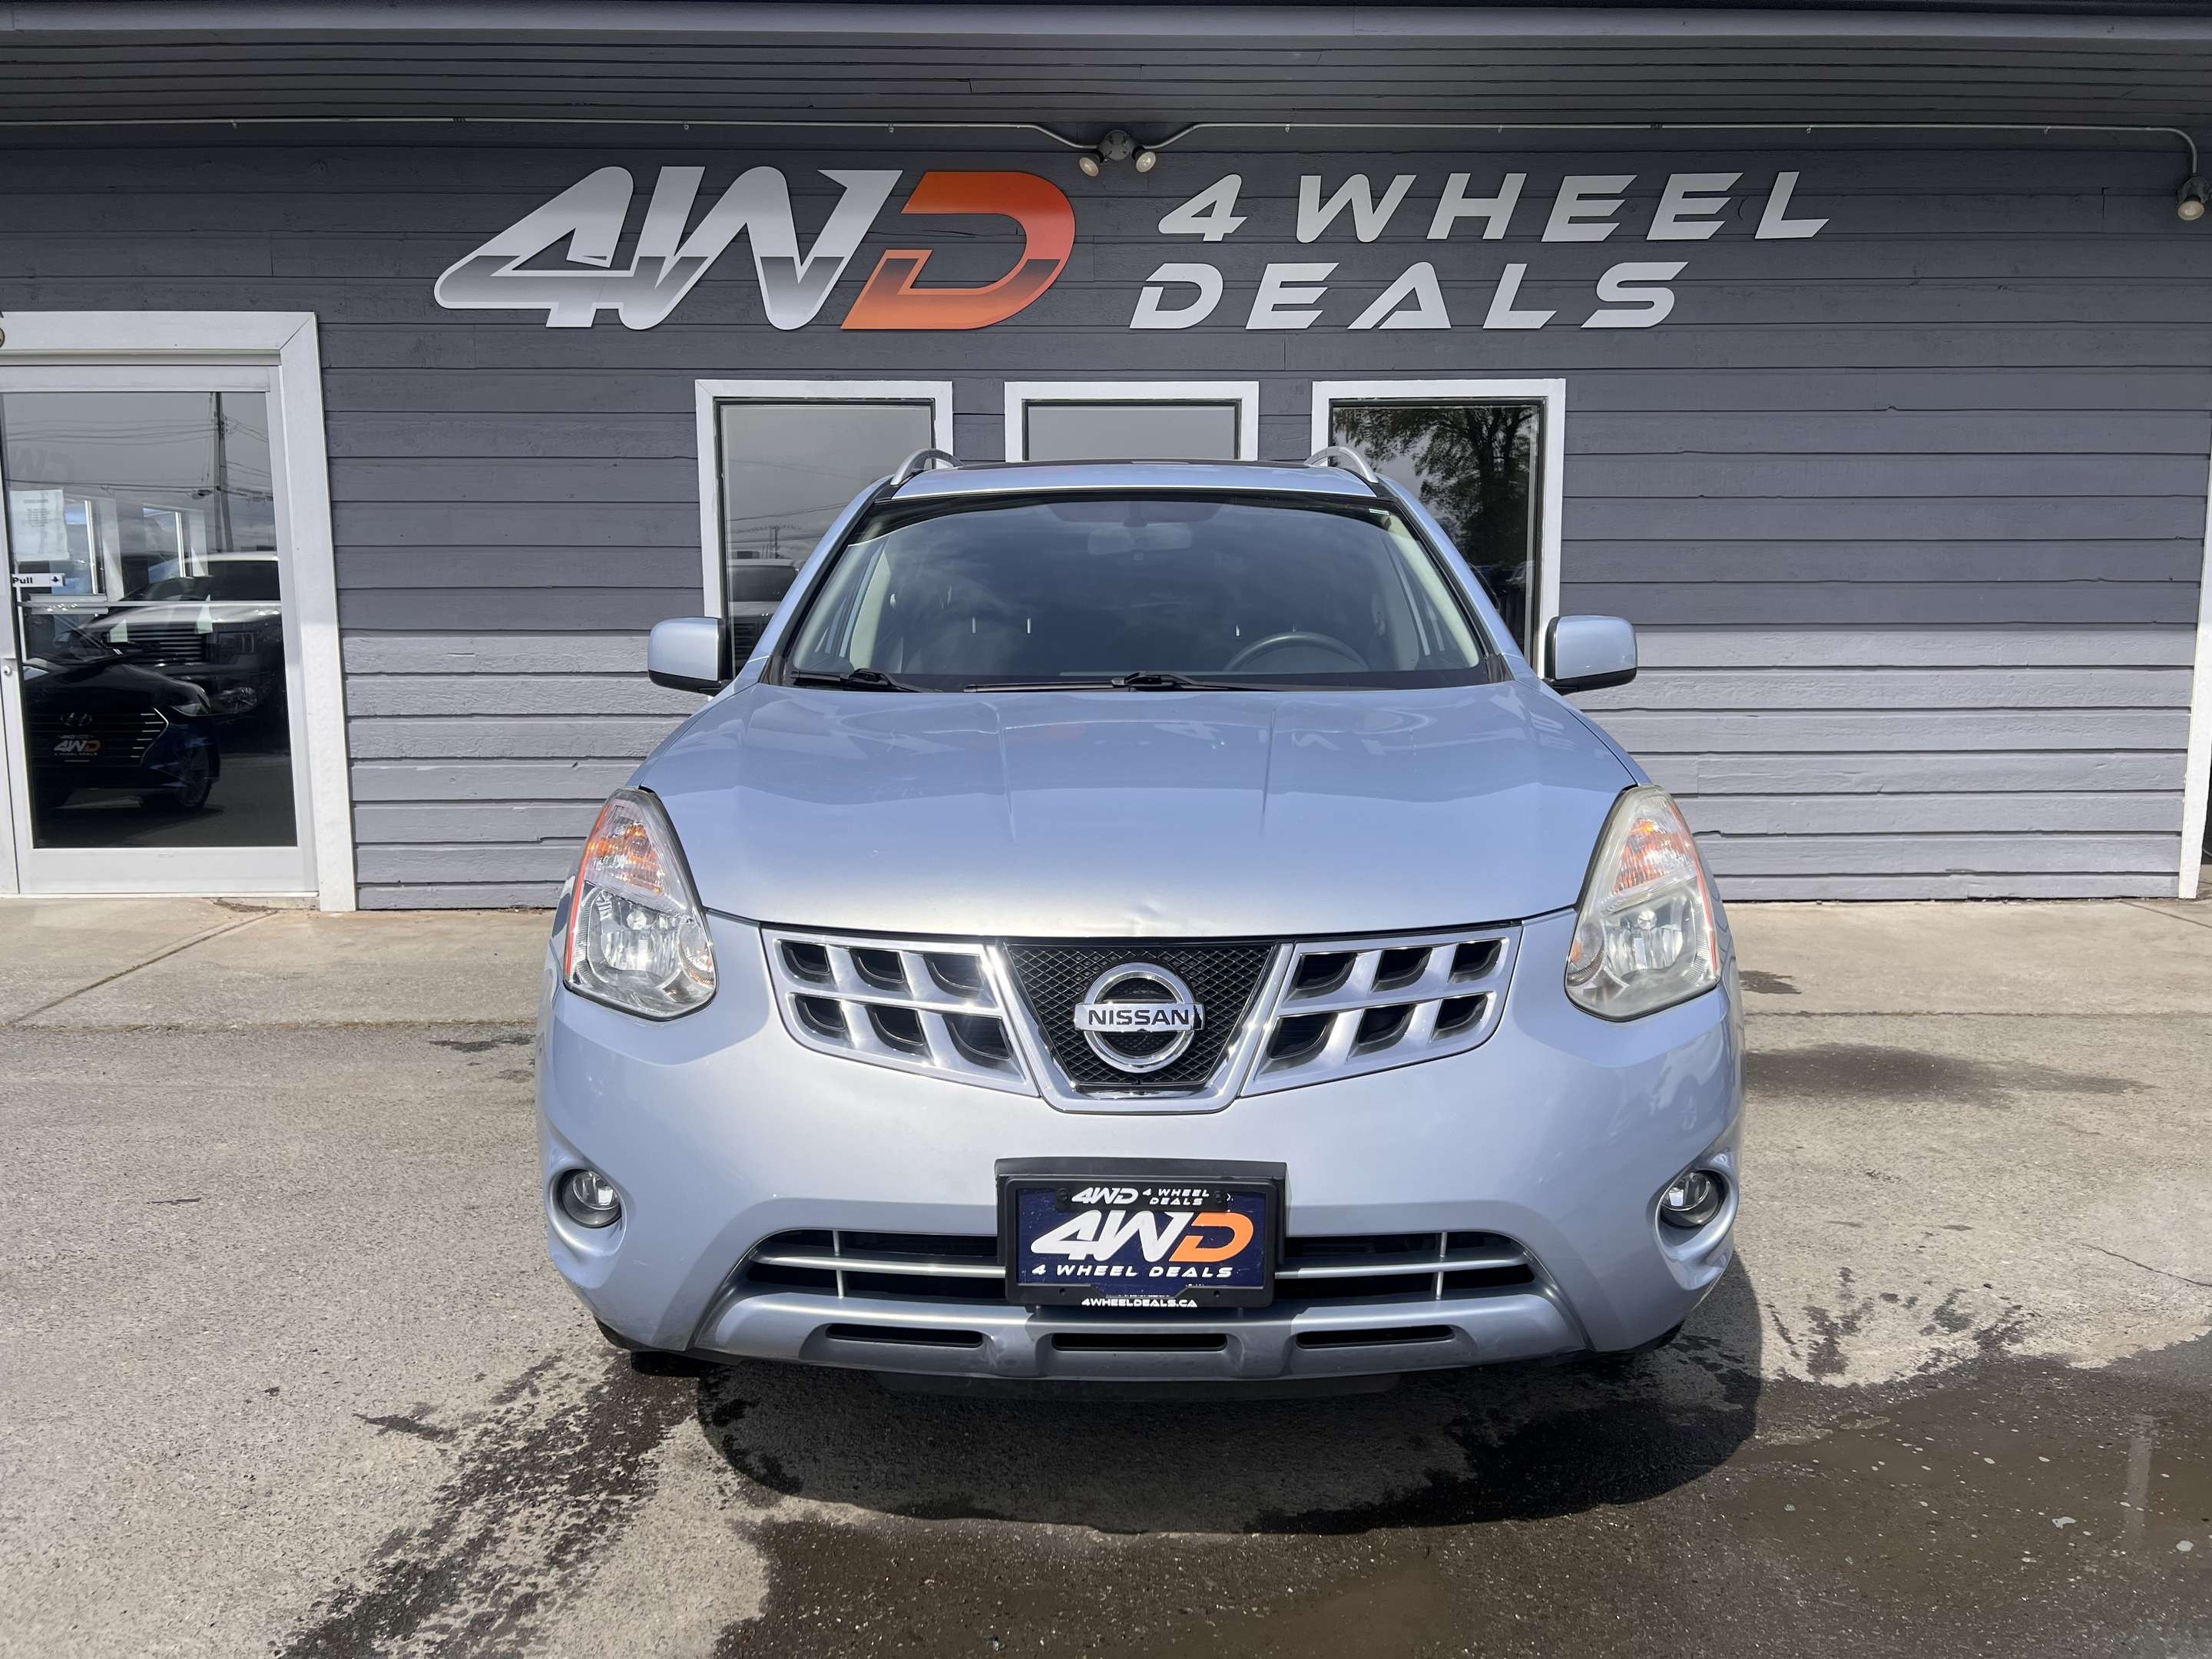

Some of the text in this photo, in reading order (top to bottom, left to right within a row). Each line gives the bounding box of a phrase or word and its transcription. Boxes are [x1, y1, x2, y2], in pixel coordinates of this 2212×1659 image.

[1157, 171, 1830, 243] 4 WHEEL
[434, 166, 1076, 330] 4WD
[1129, 261, 1688, 329] DEALS
[1088, 1009, 1190, 1025] NISSAN
[1071, 1187, 1139, 1204] 4WD
[1157, 1188, 1210, 1197] WHEEL
[1149, 1197, 1204, 1206] DEALS
[1030, 1209, 1254, 1263] 4WD
[1031, 1264, 1233, 1278] 4 WHEEL DEALS
[1081, 1297, 1198, 1308] 4WHEELDEALS.CA
